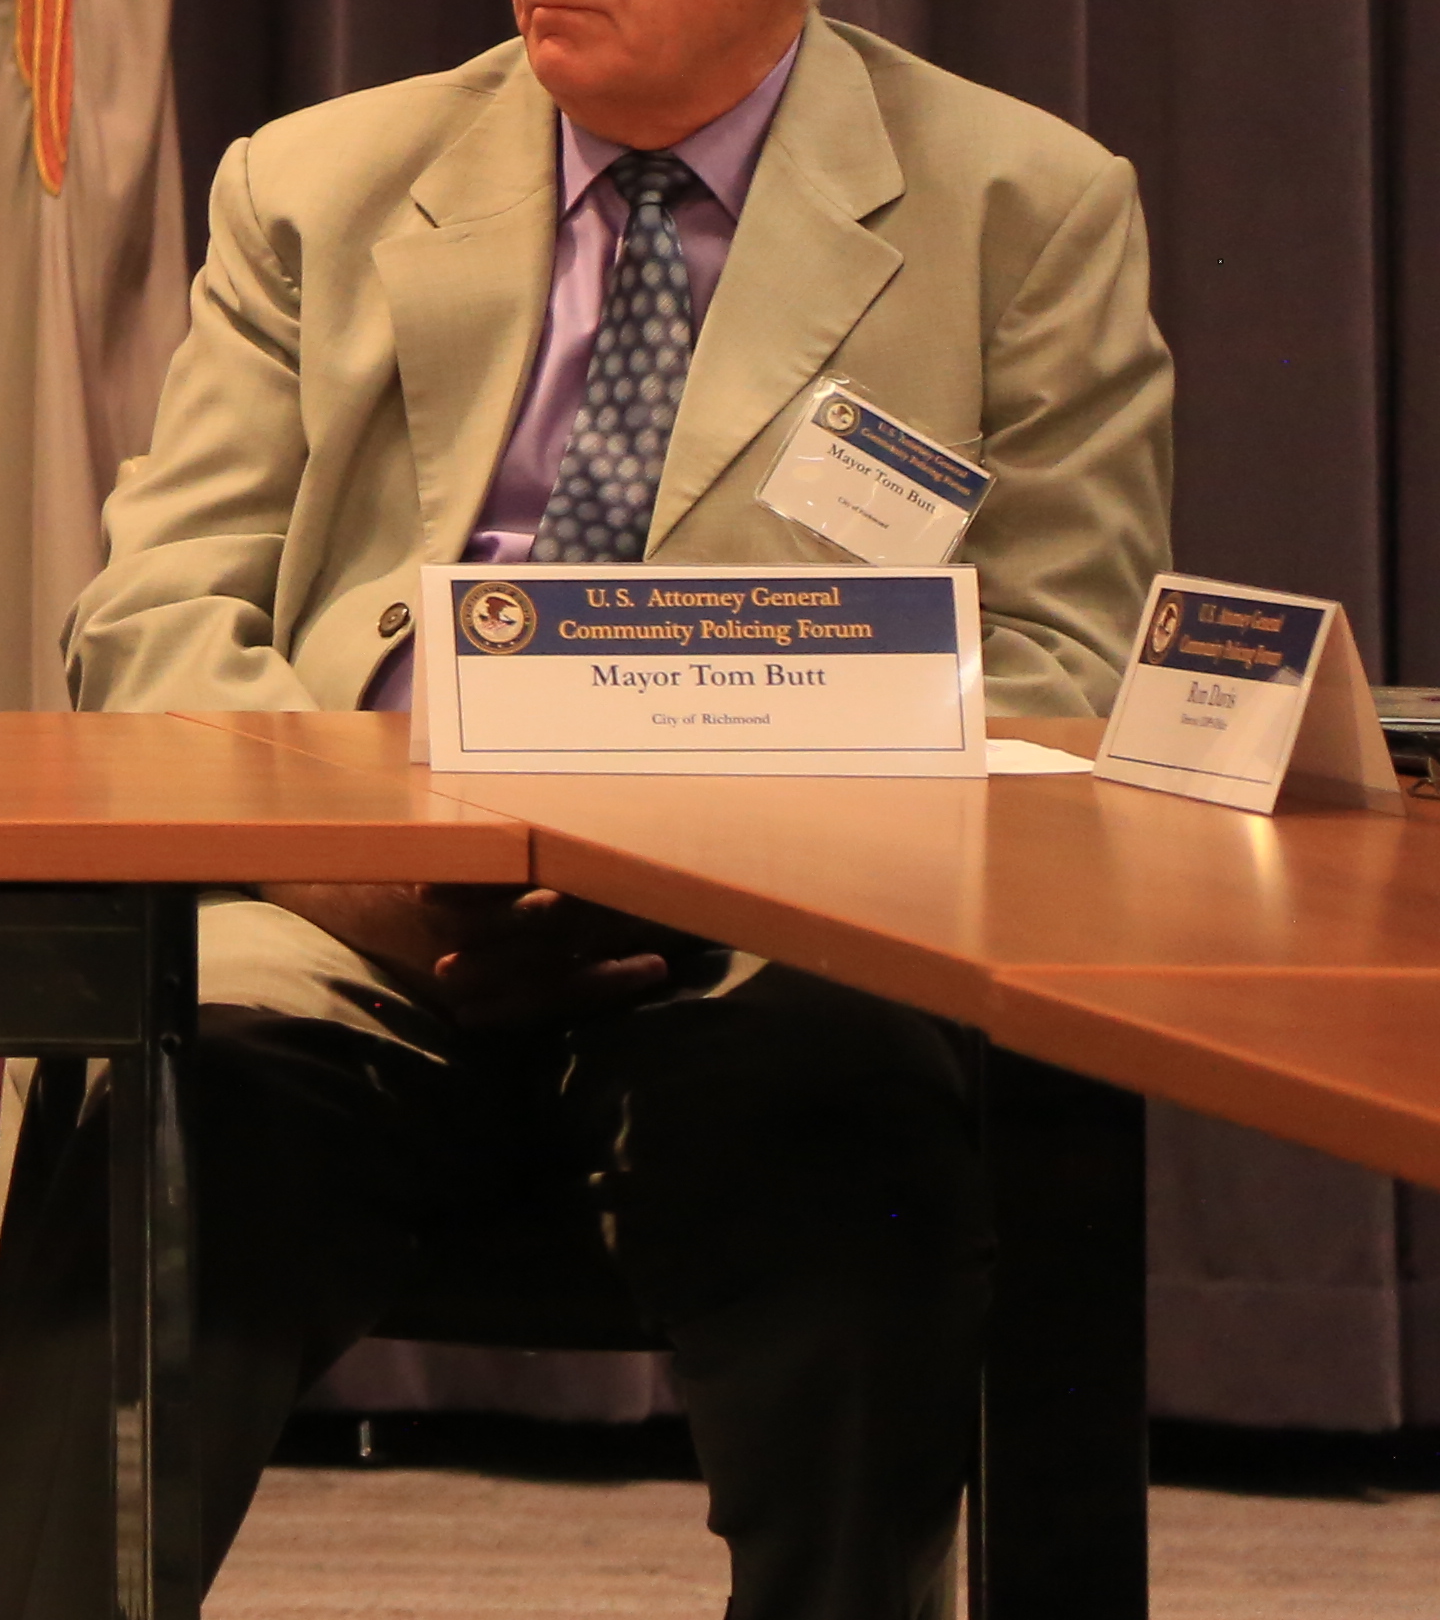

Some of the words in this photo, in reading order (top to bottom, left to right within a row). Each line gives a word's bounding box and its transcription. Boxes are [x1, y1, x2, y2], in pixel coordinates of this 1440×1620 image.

[827, 442, 873, 478] Mayor
[875, 468, 905, 497] Tom
[907, 490, 938, 515] Butt
[648, 588, 745, 613] Attorney
[750, 587, 840, 607] General
[559, 620, 694, 645] Community
[700, 619, 791, 645] Policing
[798, 619, 873, 639] Forum
[591, 664, 681, 693] Mayor
[689, 664, 755, 686] Tom
[765, 663, 826, 686] Butt
[652, 713, 678, 727] City
[682, 712, 696, 725] of
[701, 712, 770, 725] Richmond
